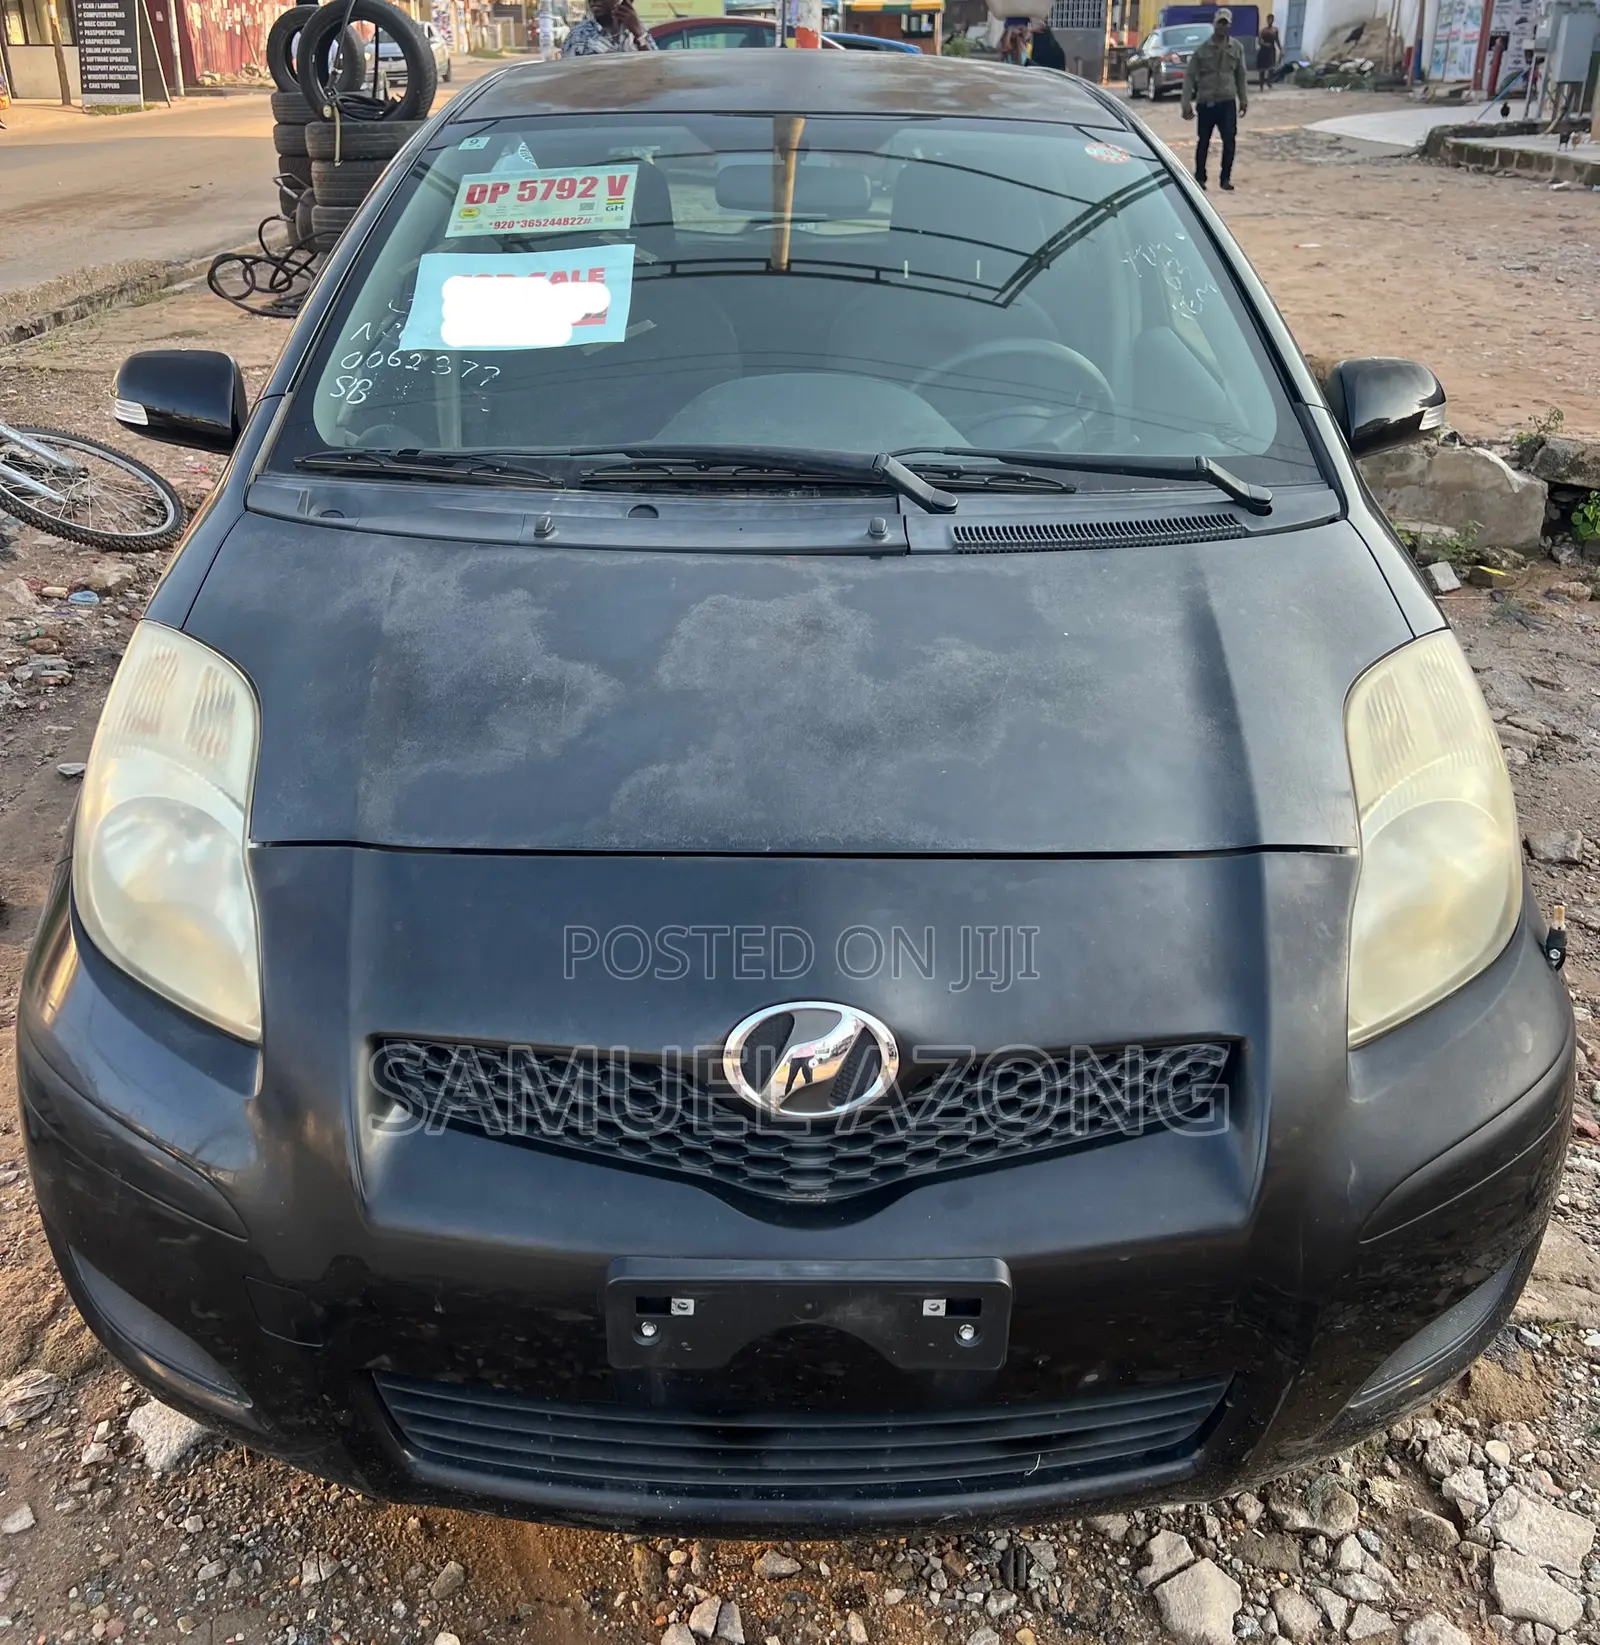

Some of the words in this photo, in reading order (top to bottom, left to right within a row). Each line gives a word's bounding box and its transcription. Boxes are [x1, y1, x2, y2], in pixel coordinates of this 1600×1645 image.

[464, 182, 510, 205] DP
[516, 176, 599, 202] 5792
[606, 174, 630, 197] V
[605, 204, 624, 212] GH
